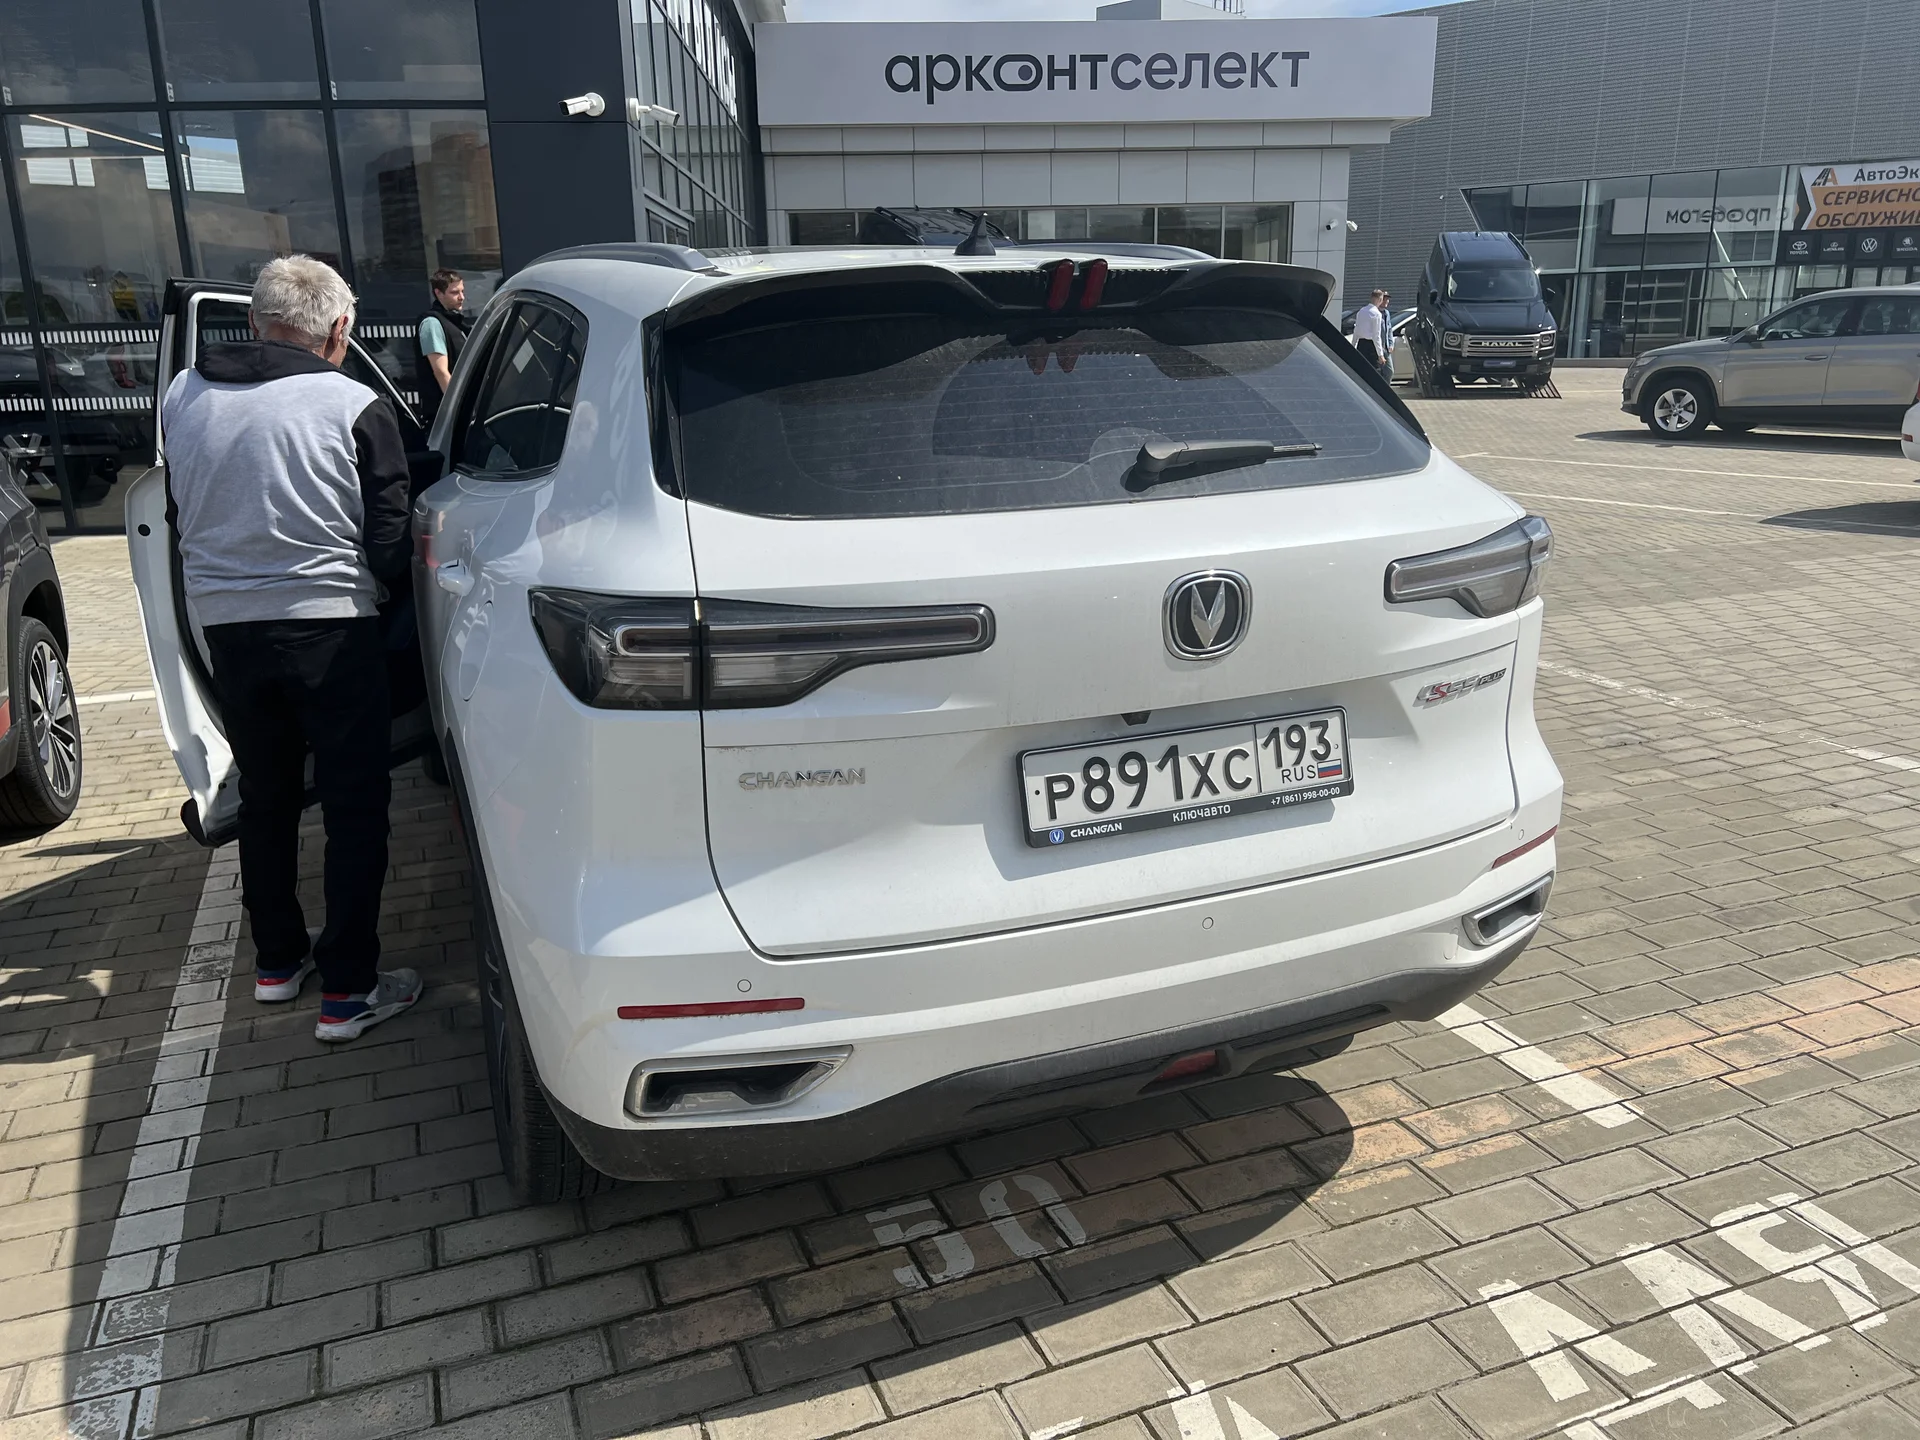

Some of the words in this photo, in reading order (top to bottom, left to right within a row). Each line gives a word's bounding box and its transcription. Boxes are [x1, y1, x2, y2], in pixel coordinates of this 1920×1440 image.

[1853, 165, 1919, 182] АвтоЭк
[1262, 719, 1332, 769] 193
[738, 767, 866, 791] CHANGAN
[1281, 767, 1317, 784] RUS
[1271, 795, 1281, 806] +7
[1282, 793, 1302, 806] (861)
[1302, 787, 1341, 801] 998-00-00
[1070, 822, 1123, 838] CHANGAN
[865, 1174, 1087, 1290] 50
